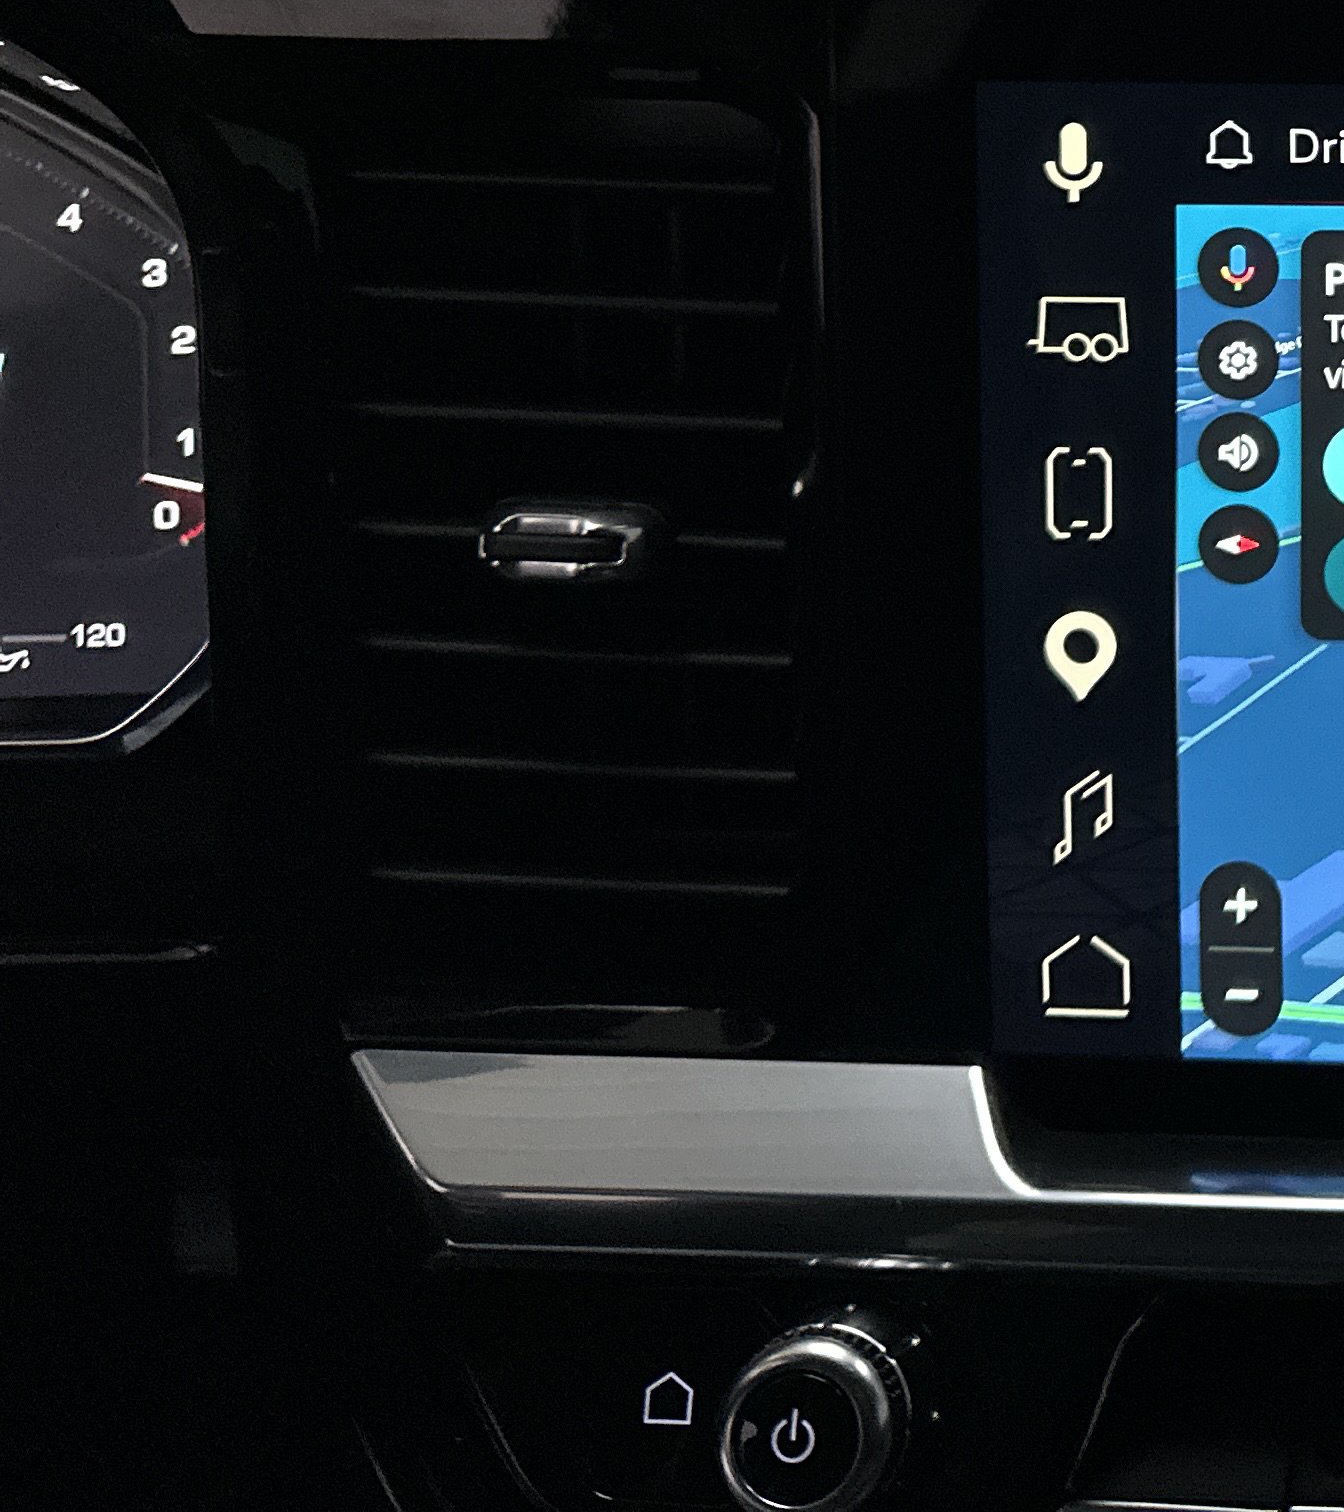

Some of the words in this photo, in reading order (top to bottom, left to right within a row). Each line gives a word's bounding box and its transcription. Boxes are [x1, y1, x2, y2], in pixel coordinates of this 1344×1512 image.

[57, 203, 83, 232] 4
[141, 260, 168, 287] 3
[171, 326, 198, 355] 2
[176, 427, 196, 456] 1
[153, 501, 181, 530] 0
[69, 621, 127, 649] 120
